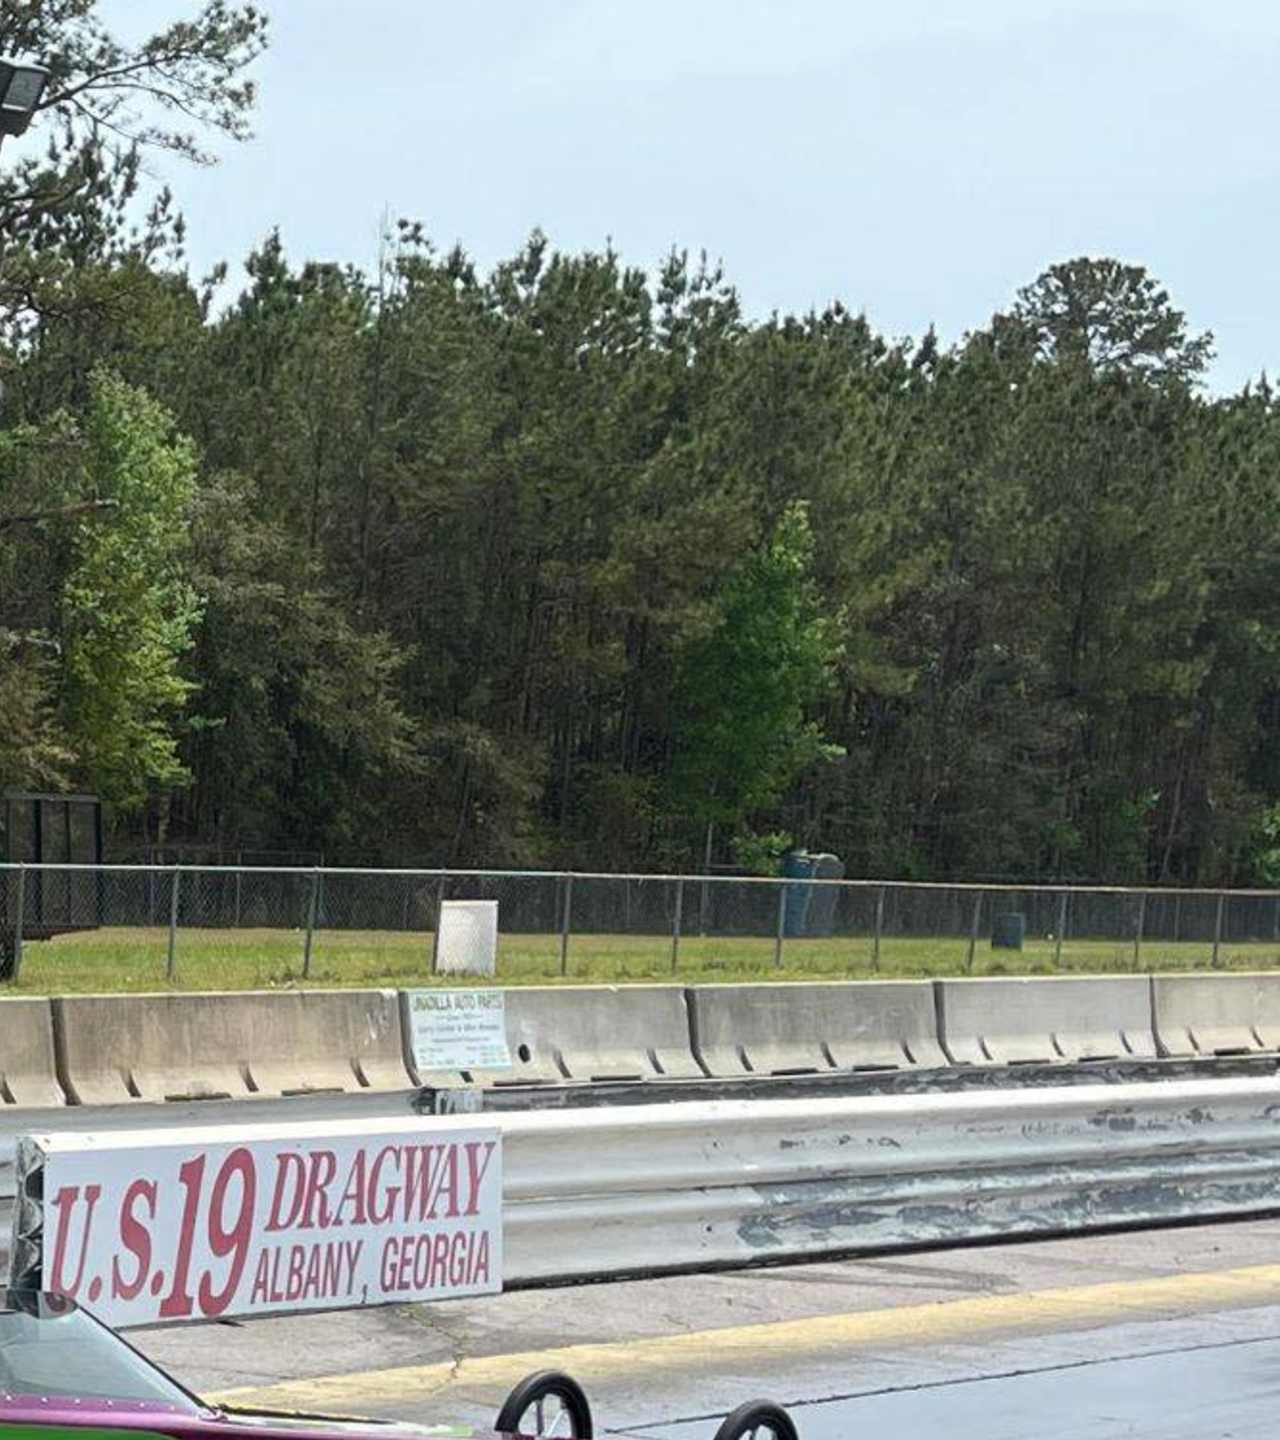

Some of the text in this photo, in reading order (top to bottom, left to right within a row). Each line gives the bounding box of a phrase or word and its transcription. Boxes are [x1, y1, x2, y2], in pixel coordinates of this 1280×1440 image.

[264, 1141, 496, 1232] DRAGWAY
[251, 1230, 491, 1305] ALBANY, GEORGIA
